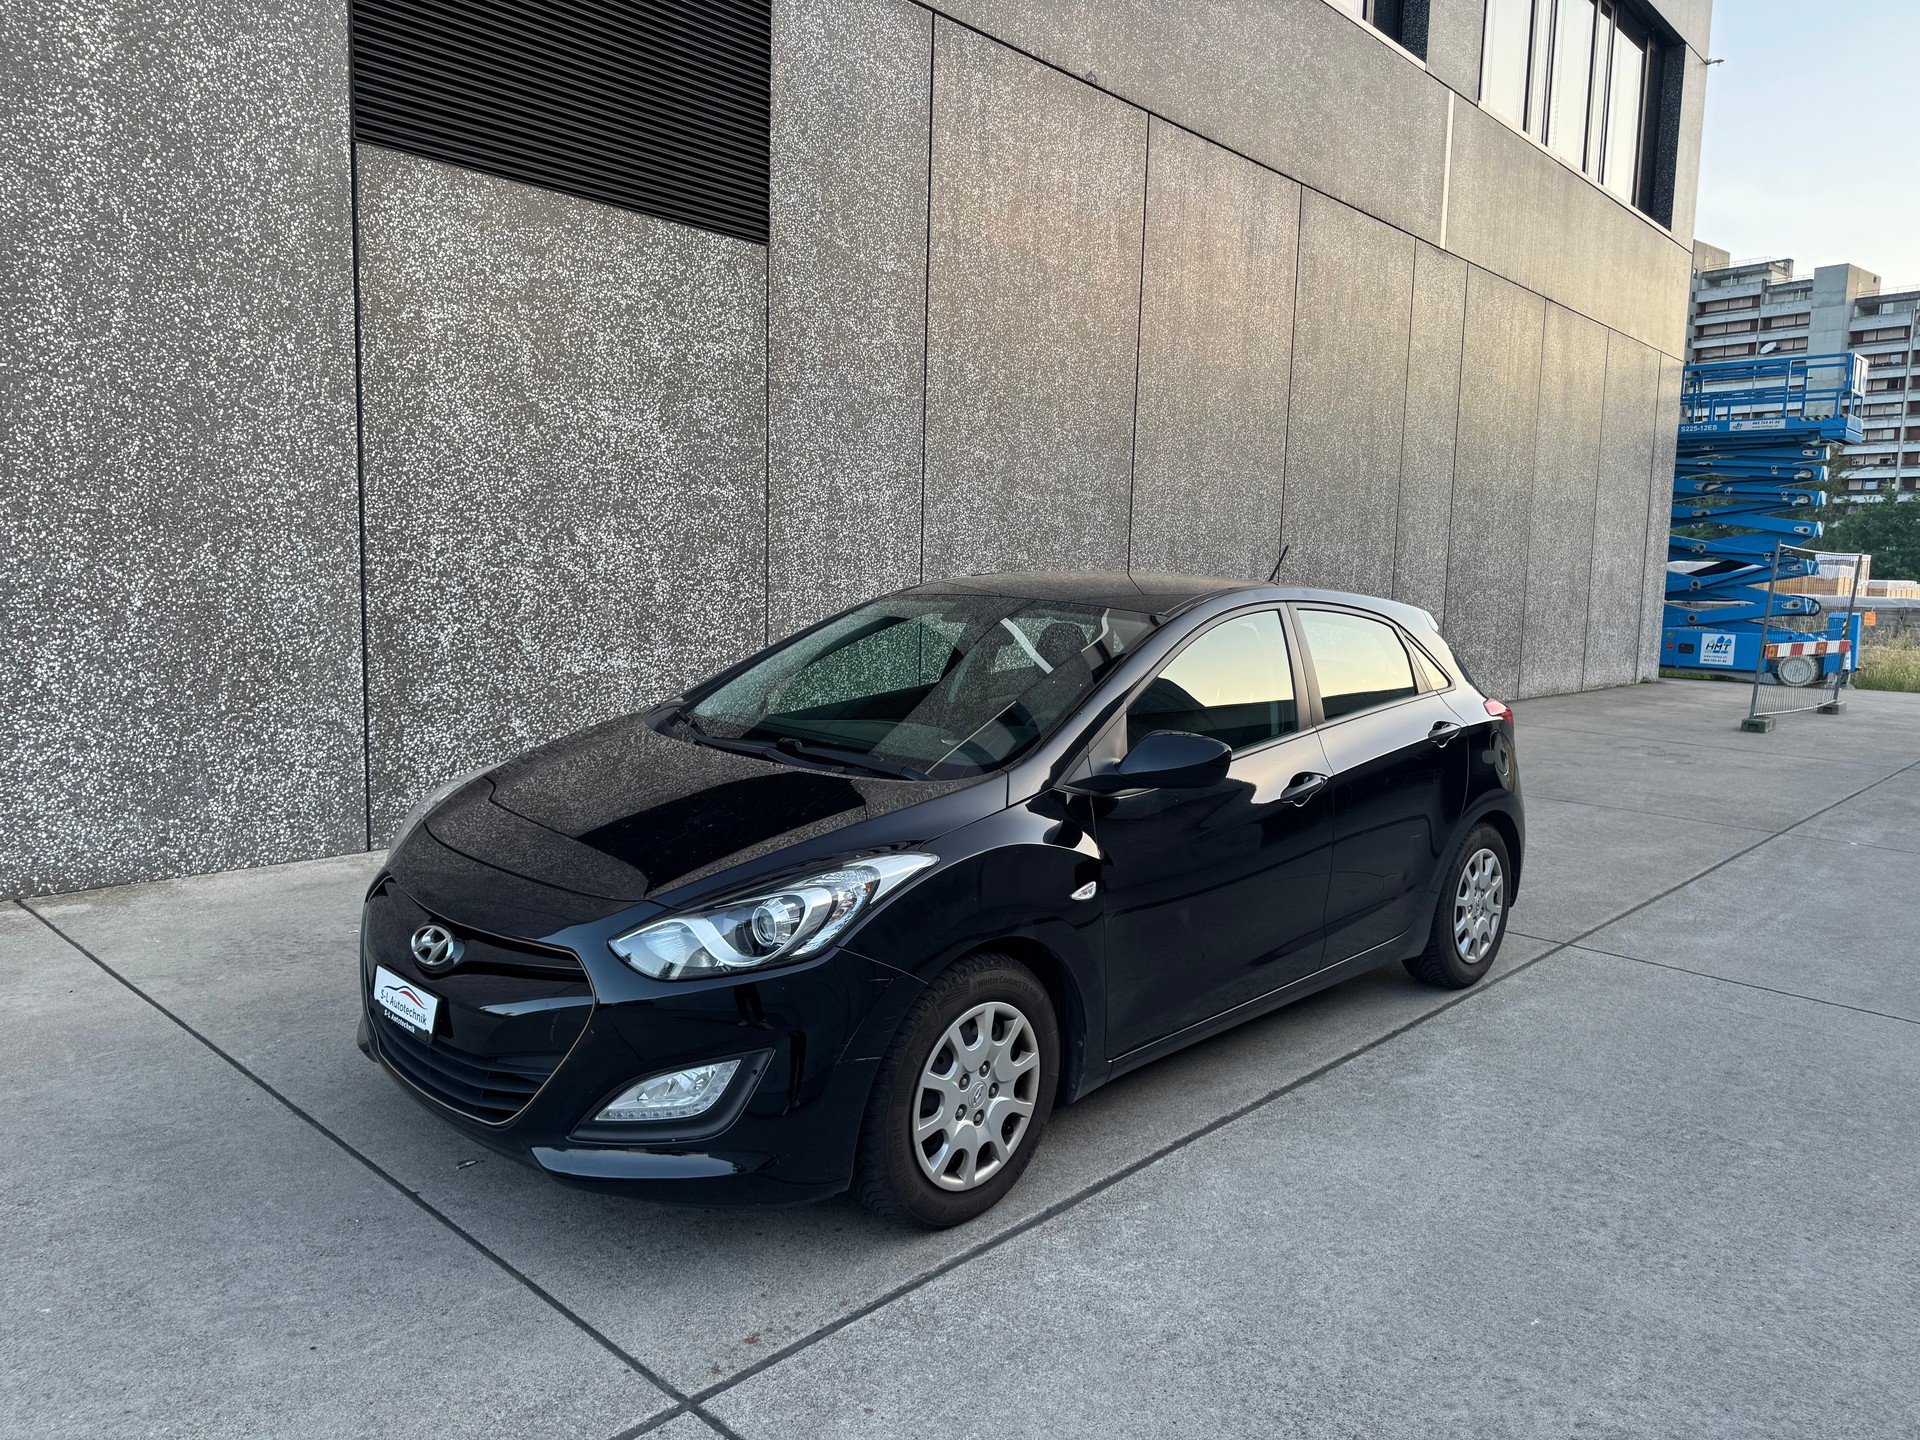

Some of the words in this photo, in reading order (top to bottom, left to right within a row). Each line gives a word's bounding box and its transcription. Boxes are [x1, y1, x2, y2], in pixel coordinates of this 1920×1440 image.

[381, 989, 389, 1003] S-L
[390, 996, 427, 1025] Autotechnik
[391, 1013, 415, 1033] Autotechnik
